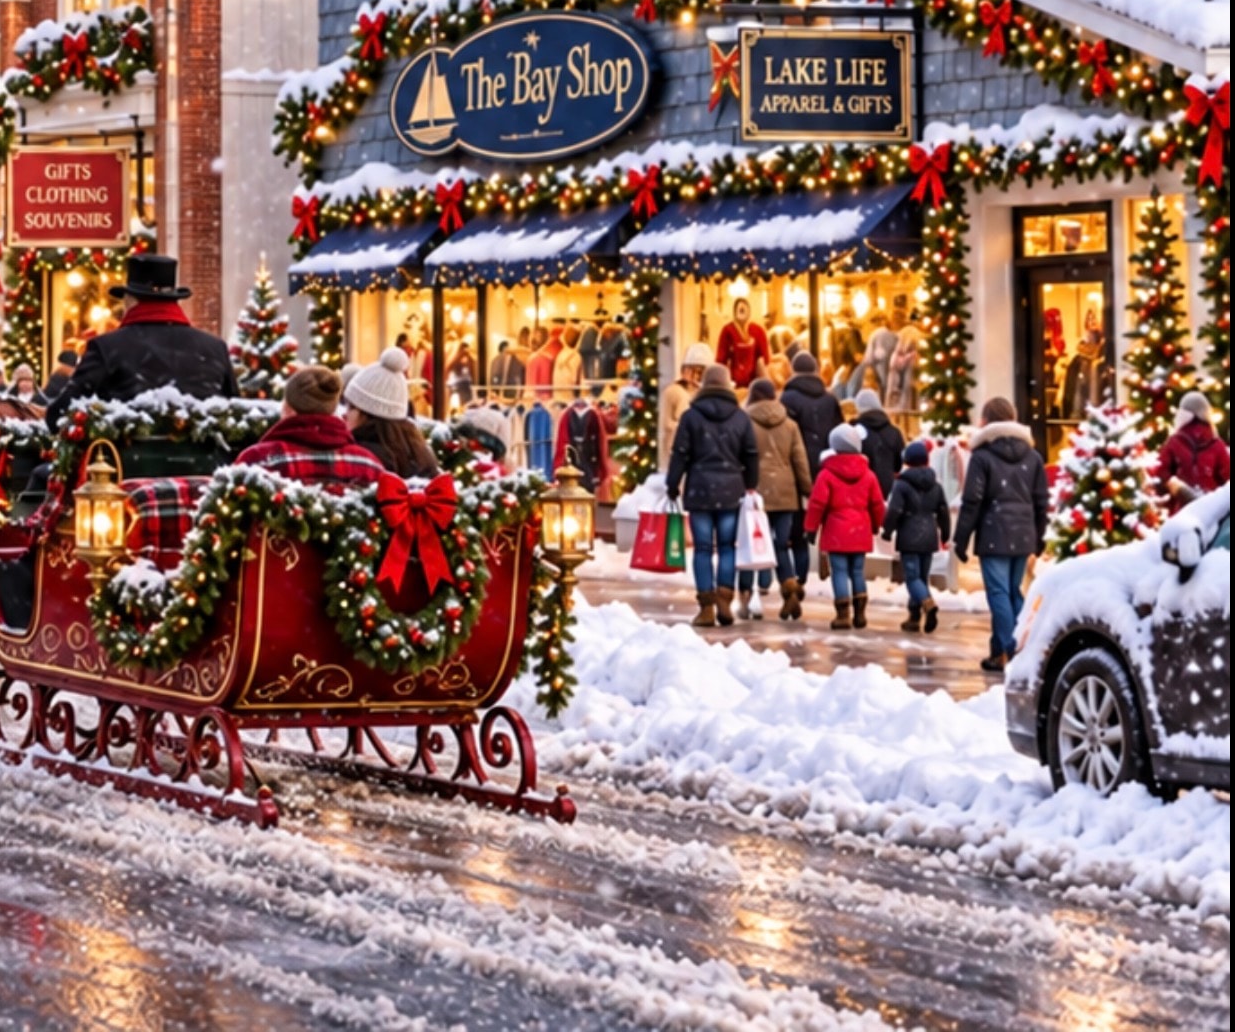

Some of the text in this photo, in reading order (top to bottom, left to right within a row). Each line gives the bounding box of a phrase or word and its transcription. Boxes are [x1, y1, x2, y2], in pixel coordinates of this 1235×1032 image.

[764, 56, 887, 85] LAKE LIFE
[460, 41, 633, 125] The Bay Shop
[759, 94, 893, 114] APPAREL & GIFTS
[44, 163, 92, 180] GIFTS
[25, 186, 108, 204] CLOTHING
[24, 212, 112, 230] SOUVENIRS
